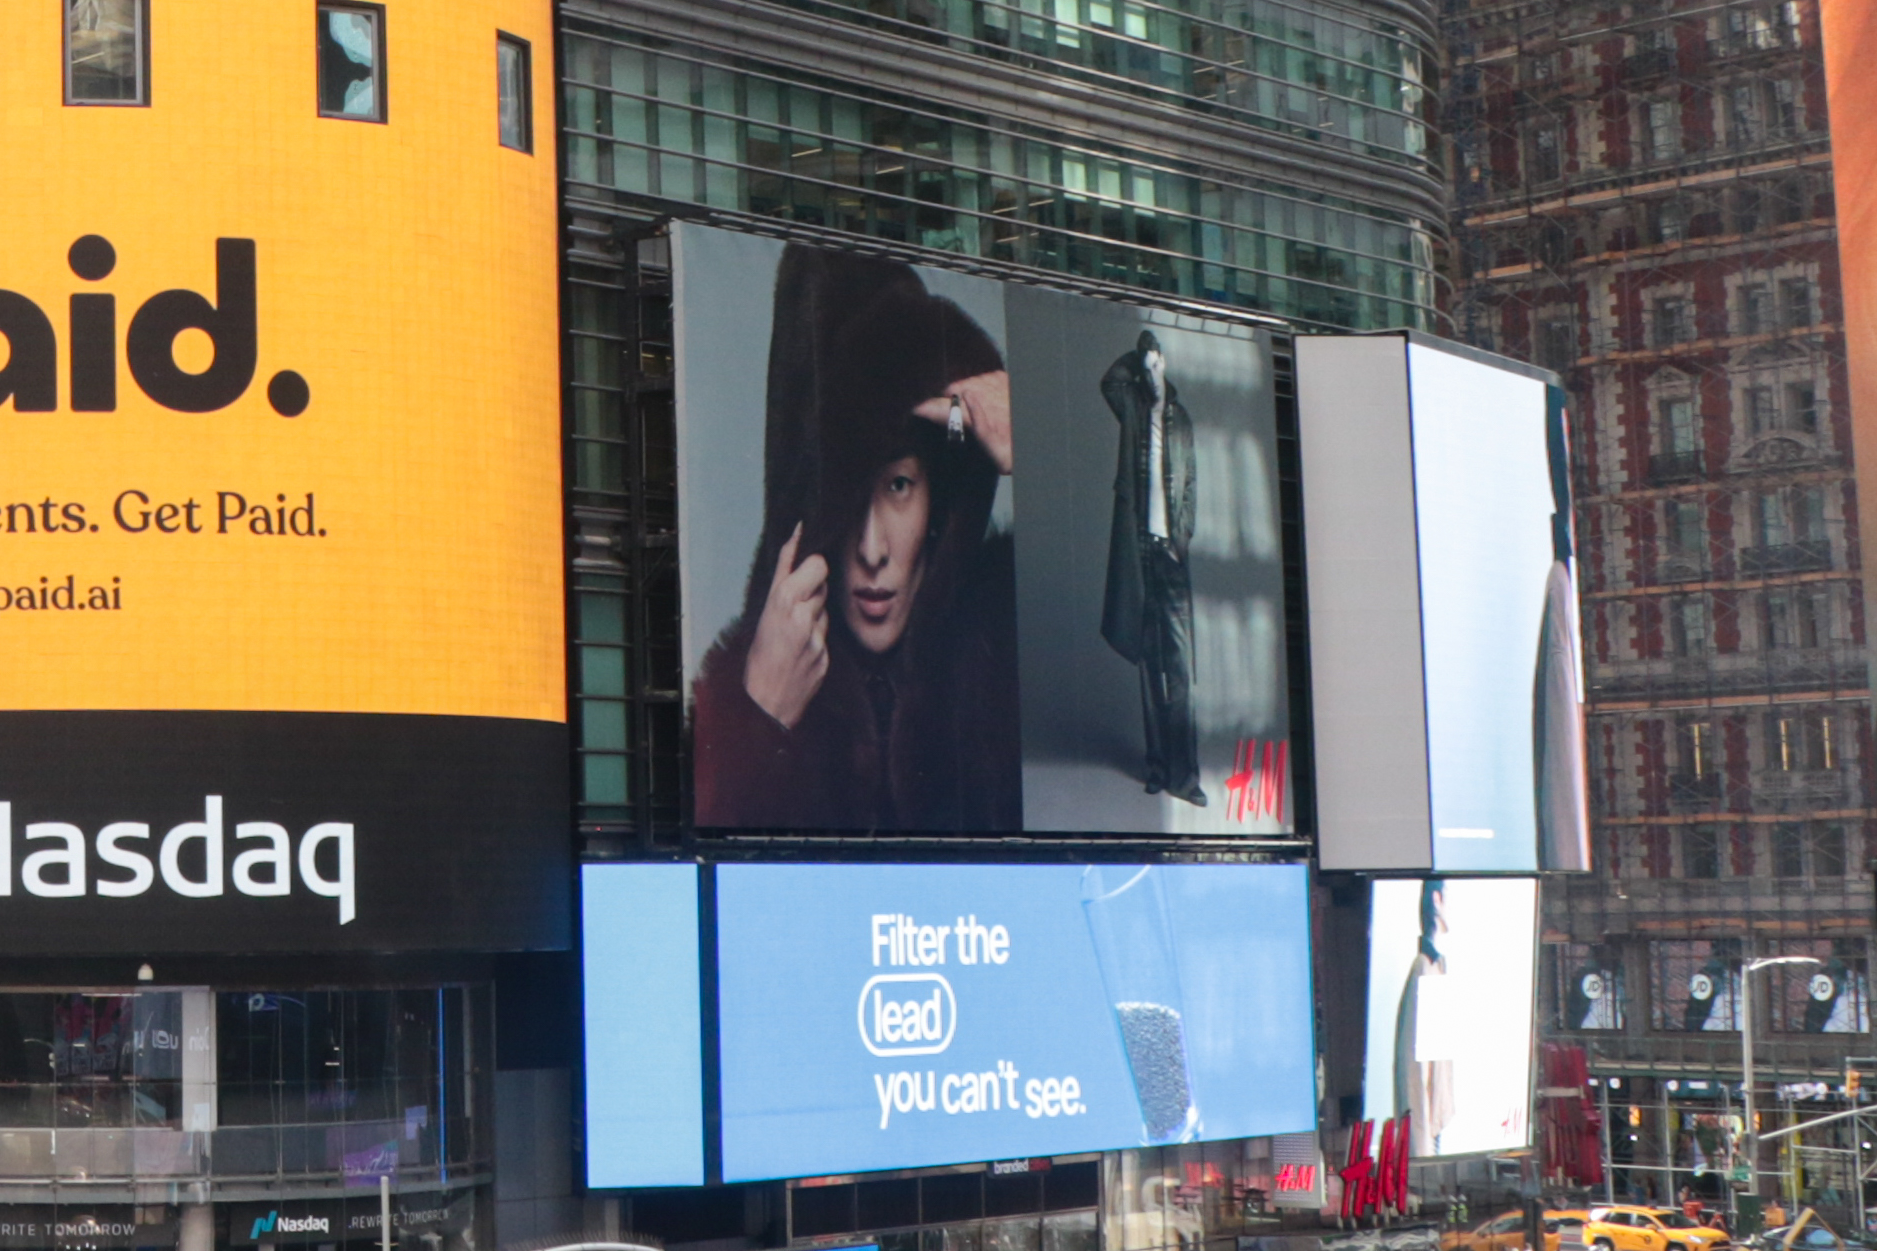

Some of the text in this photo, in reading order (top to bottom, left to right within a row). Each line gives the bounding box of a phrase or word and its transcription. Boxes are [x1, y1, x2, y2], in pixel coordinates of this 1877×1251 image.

[113, 489, 203, 536] Get
[216, 491, 327, 538] Paid.
[1224, 738, 1289, 824] H&M
[872, 913, 1010, 966] Filter the
[874, 988, 942, 1043] lead
[874, 1059, 1087, 1130] you can't see.
[1276, 1163, 1317, 1192] H&M
[1339, 1115, 1412, 1219] H&M
[44, 1223, 137, 1236] TOMORROW
[277, 1214, 330, 1234] Nasdaq
[351, 1213, 399, 1229] REWRE
